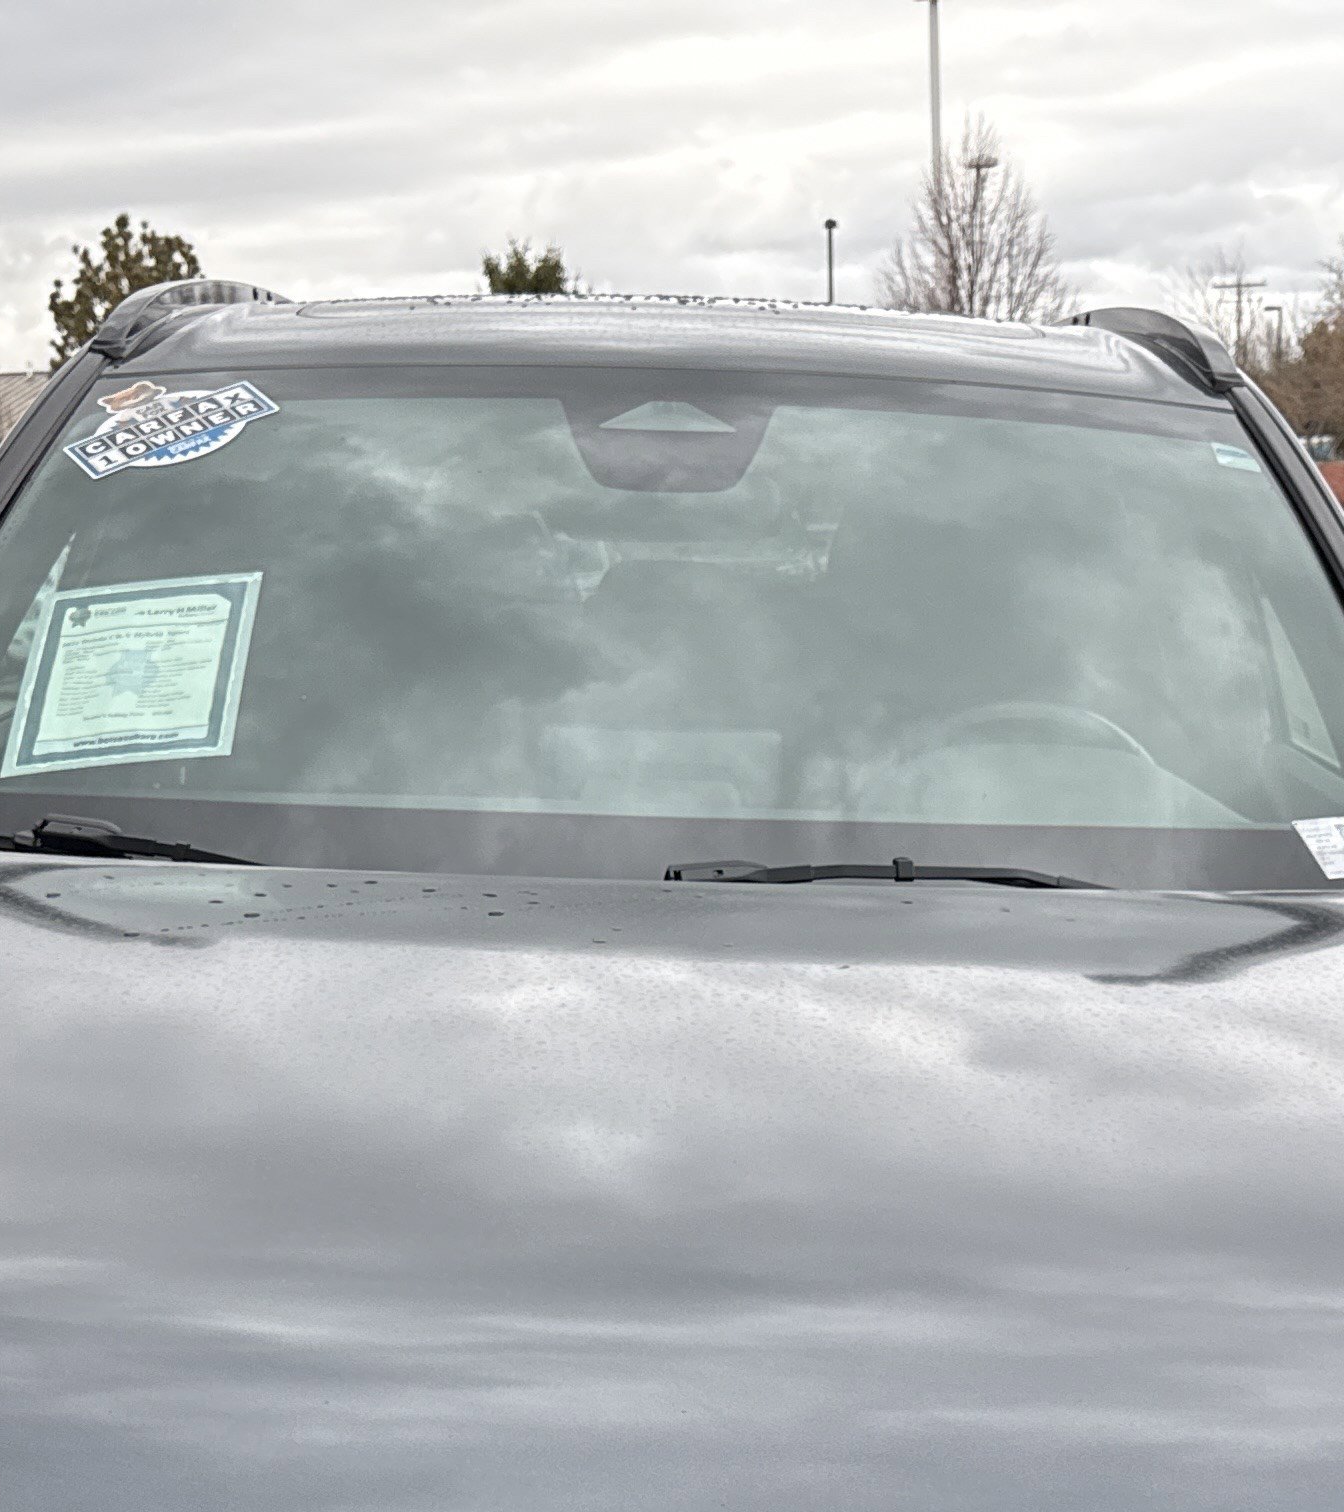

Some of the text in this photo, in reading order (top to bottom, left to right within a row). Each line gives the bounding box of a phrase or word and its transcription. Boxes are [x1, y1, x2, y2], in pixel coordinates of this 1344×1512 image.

[85, 391, 246, 454] CARFAX
[97, 454, 119, 467] 1
[125, 401, 259, 454] OWNER
